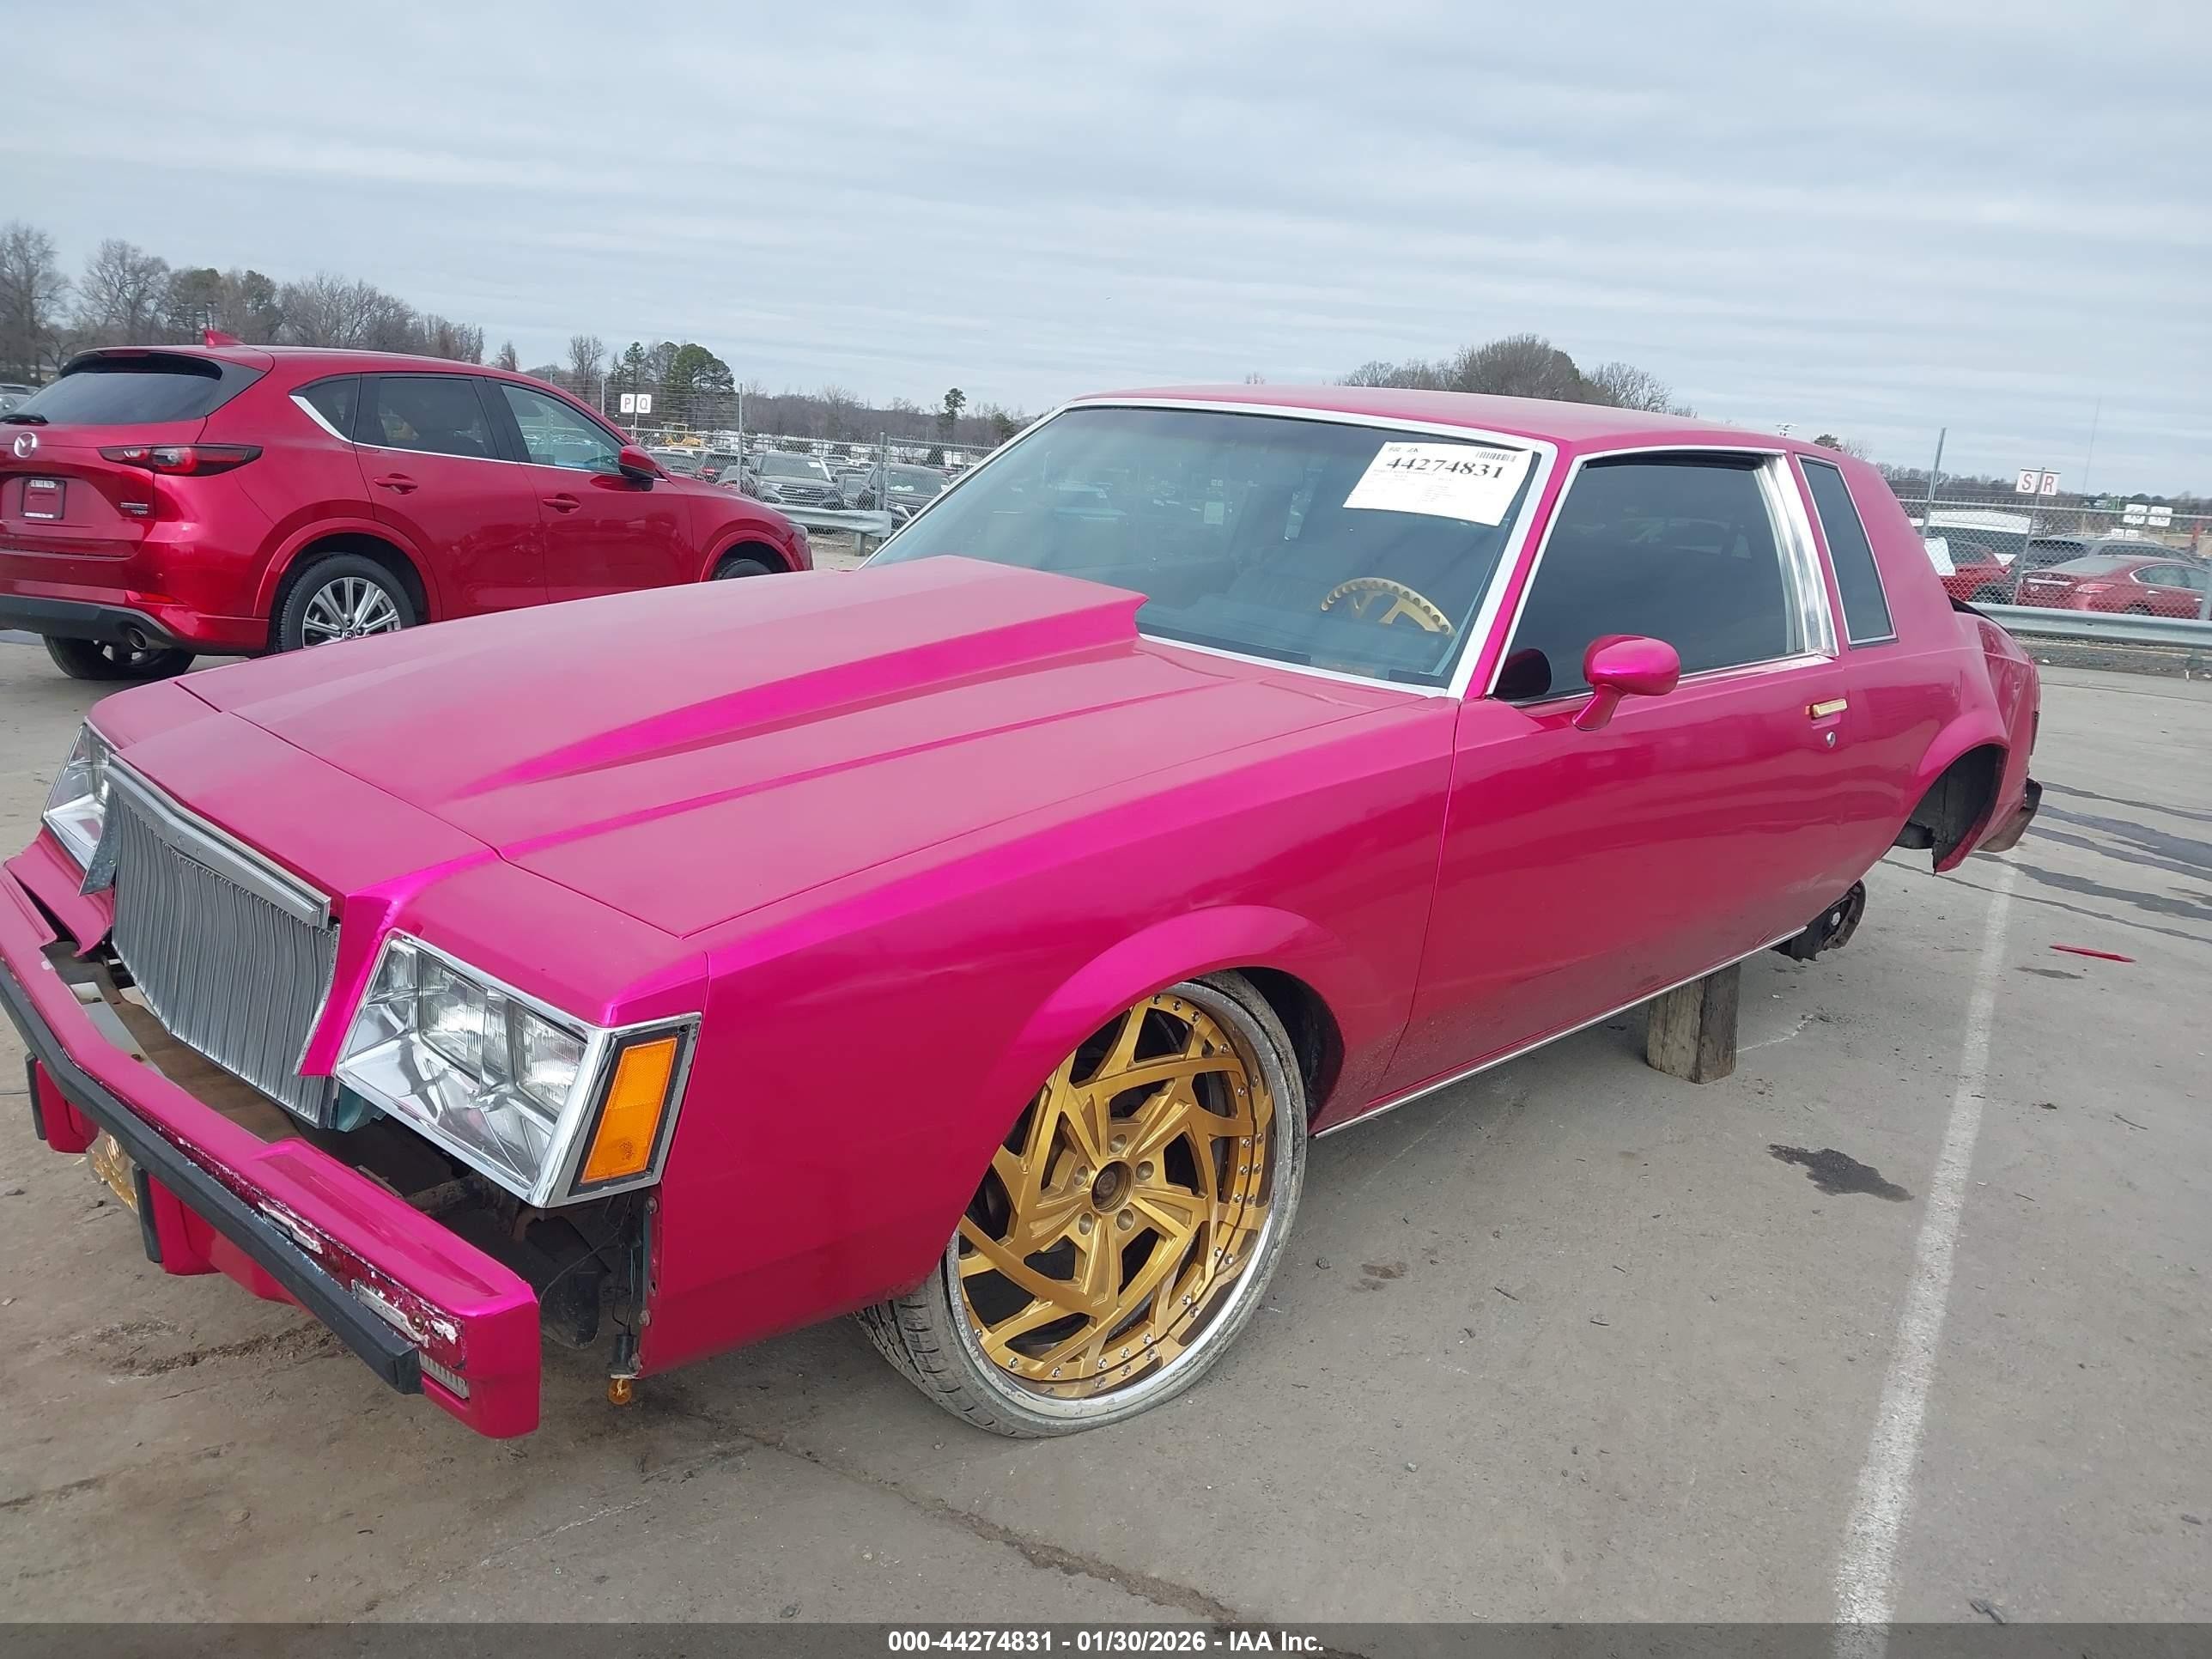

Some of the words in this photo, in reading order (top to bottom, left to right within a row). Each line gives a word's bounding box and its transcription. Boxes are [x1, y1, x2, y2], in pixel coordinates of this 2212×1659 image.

[623, 397, 631, 410] P
[639, 398, 649, 410] Q
[1386, 456, 1504, 479] 44274831
[2021, 473, 2033, 491] S
[2043, 475, 2055, 494] R
